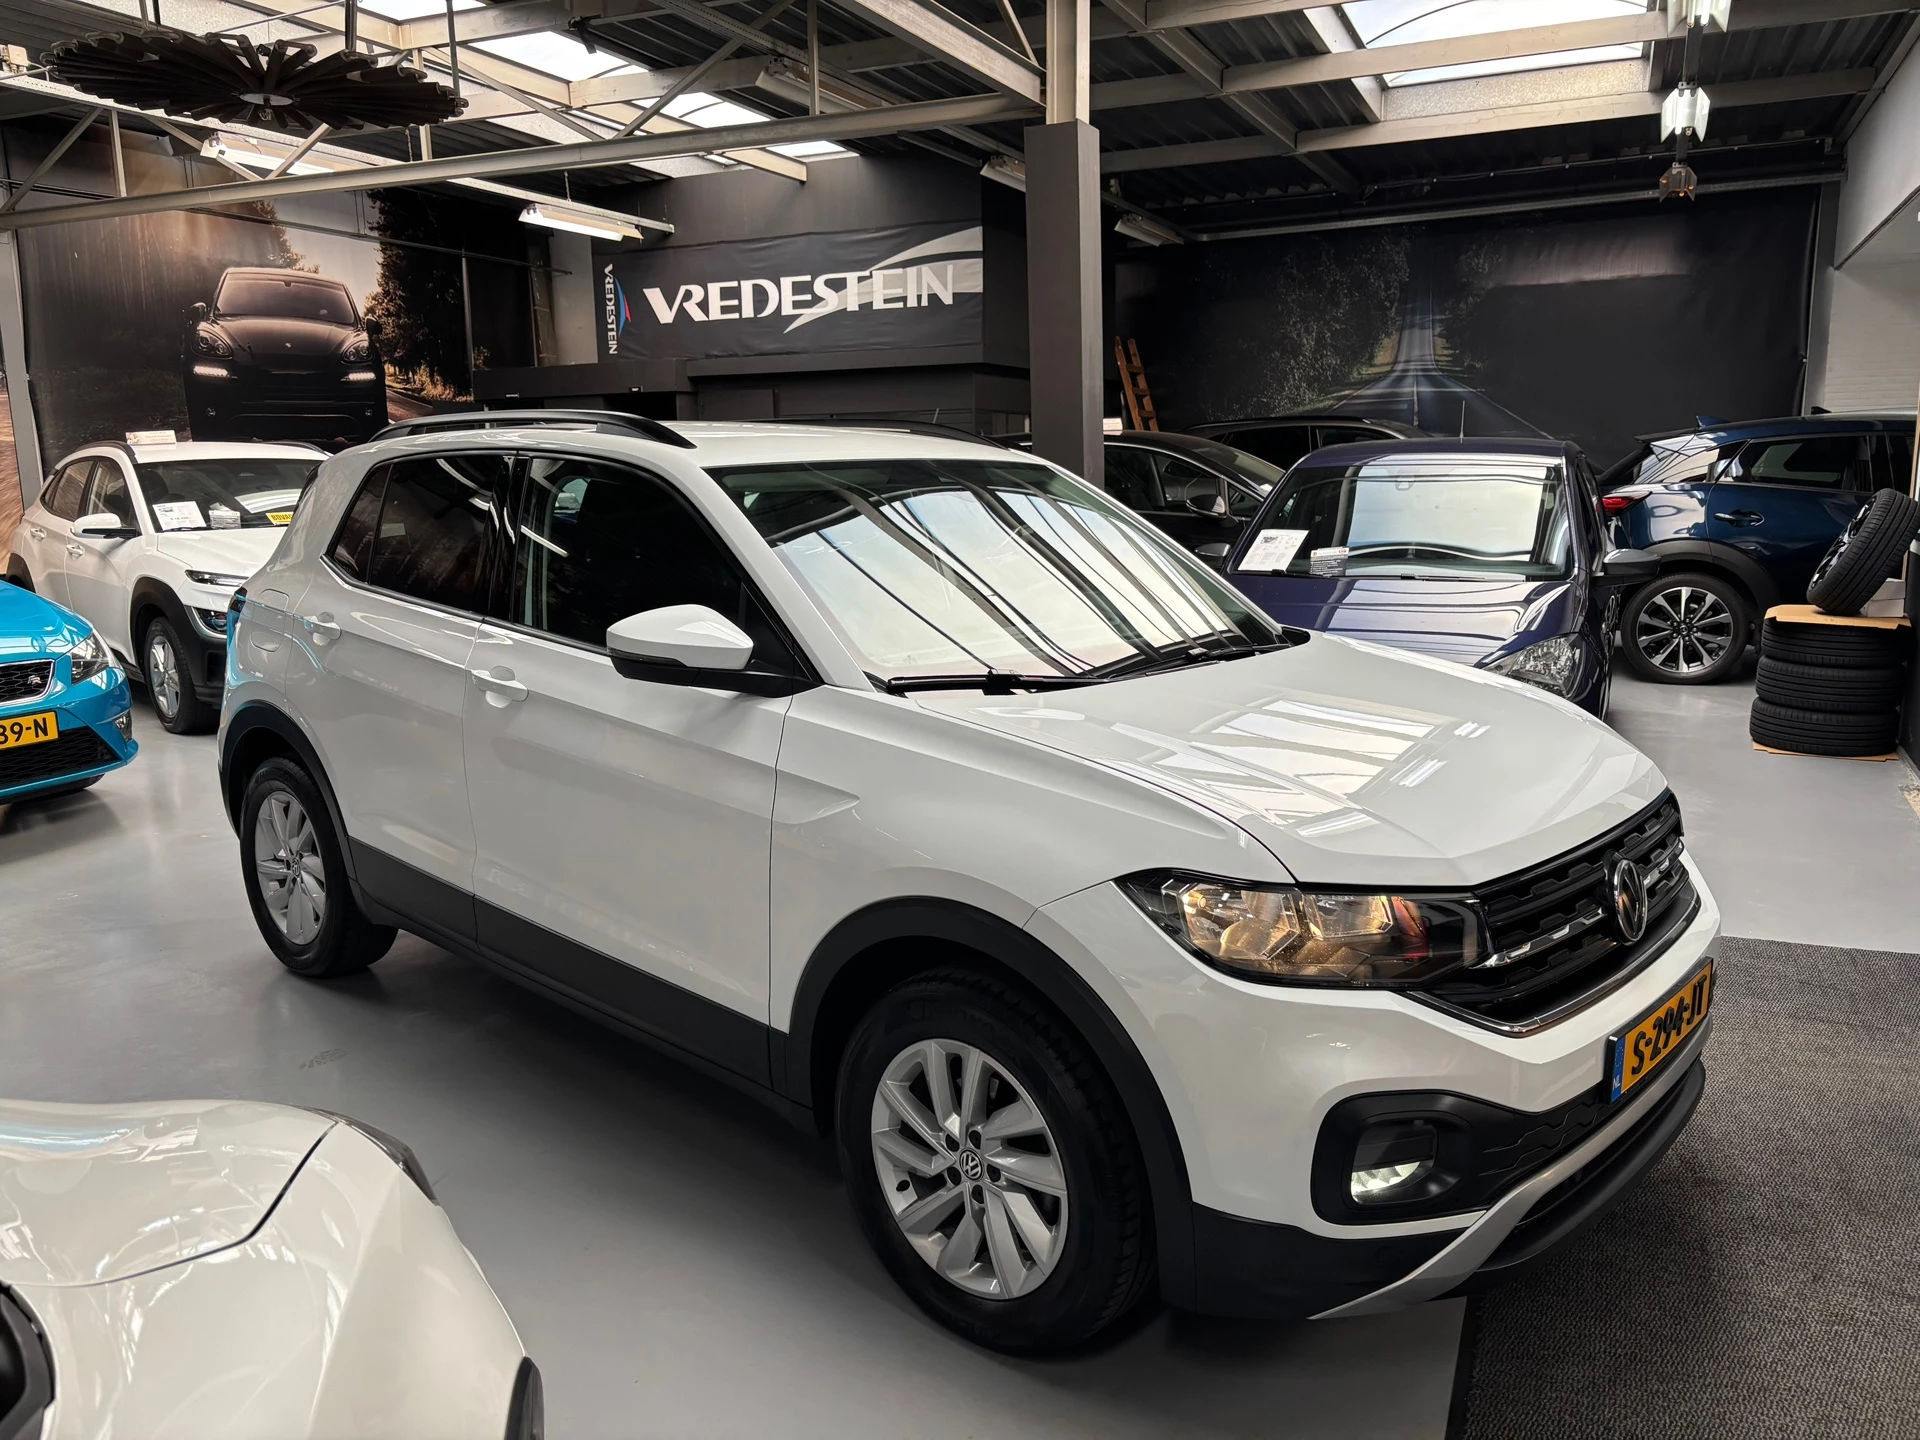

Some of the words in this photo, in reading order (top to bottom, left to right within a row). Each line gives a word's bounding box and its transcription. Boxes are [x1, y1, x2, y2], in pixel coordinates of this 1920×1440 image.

[604, 263, 618, 354] VREDESTEIN
[642, 264, 954, 325] VREDESTEIN
[1631, 974, 1707, 1076] S-294-JT
